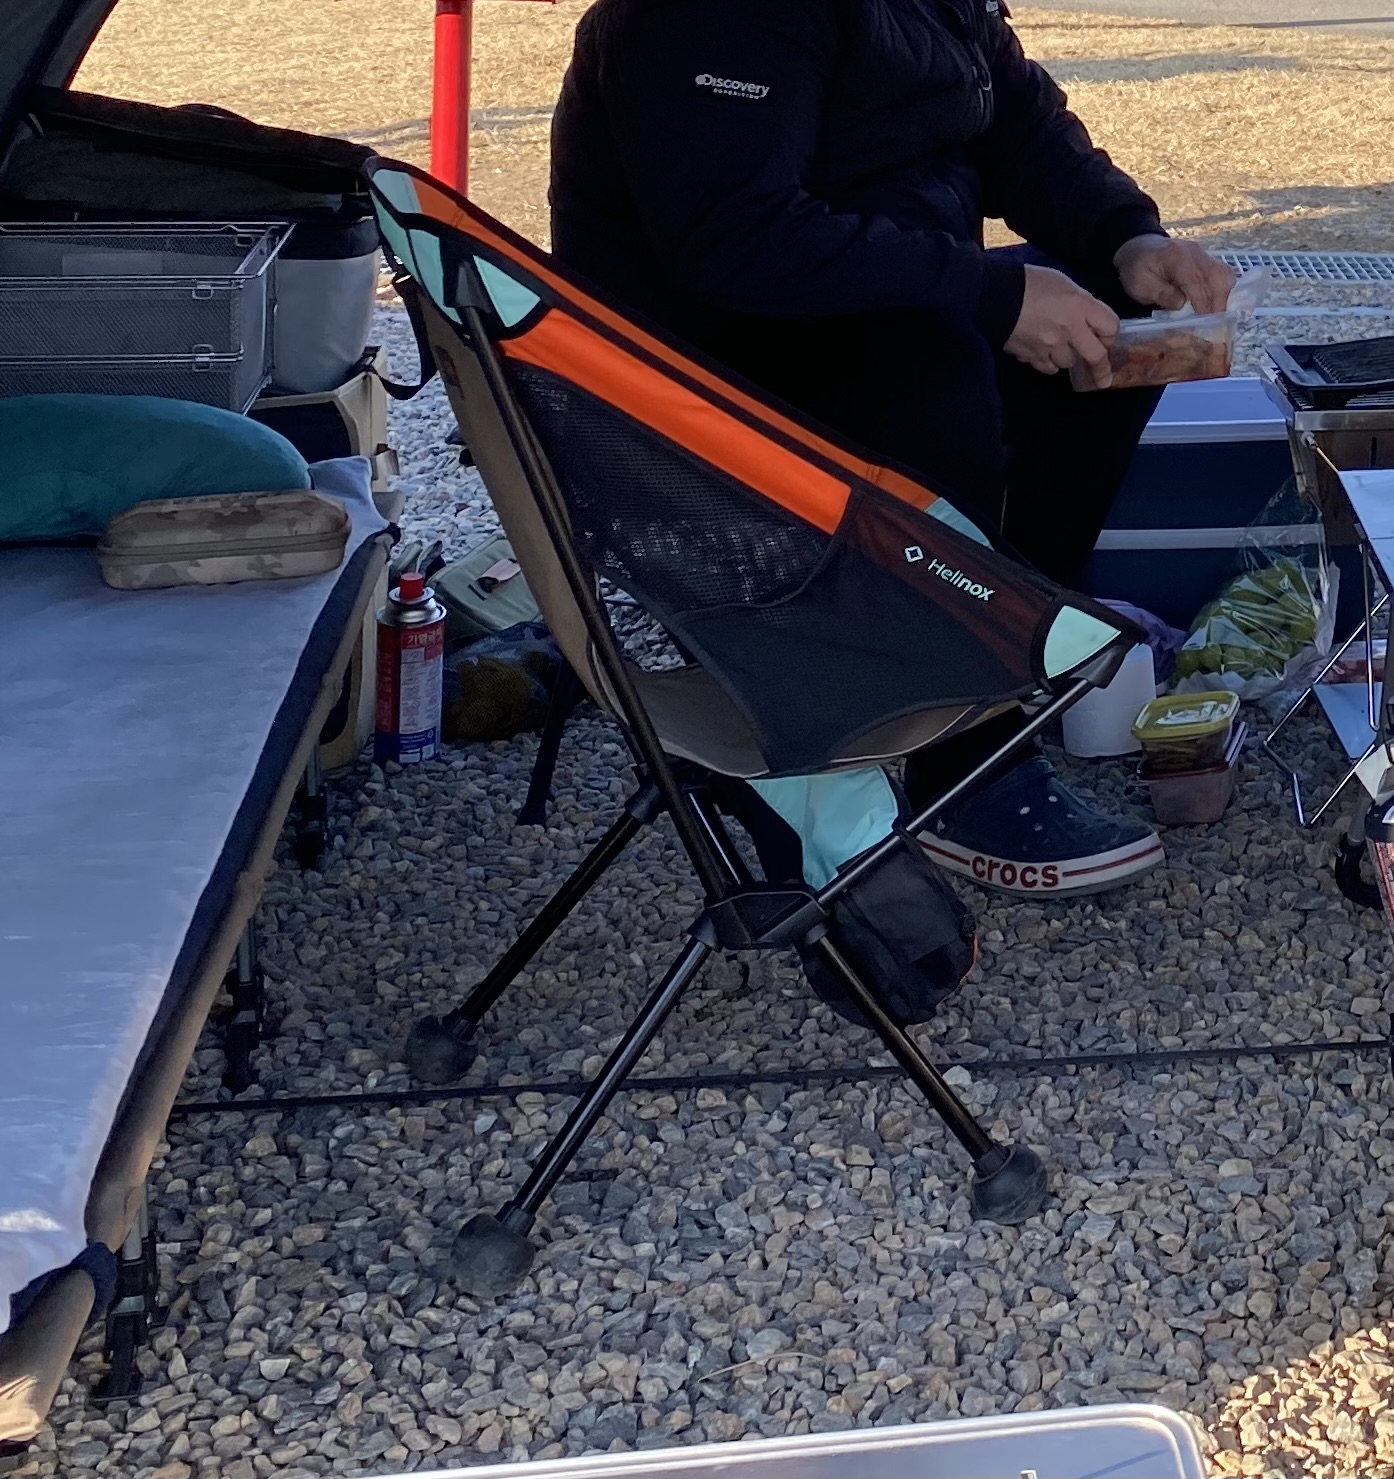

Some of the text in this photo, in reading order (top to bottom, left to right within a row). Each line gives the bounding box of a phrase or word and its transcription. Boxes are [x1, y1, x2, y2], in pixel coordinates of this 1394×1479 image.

[695, 73, 770, 98] Discovery
[927, 558, 995, 601] Helinox
[971, 856, 1058, 888] crocs
